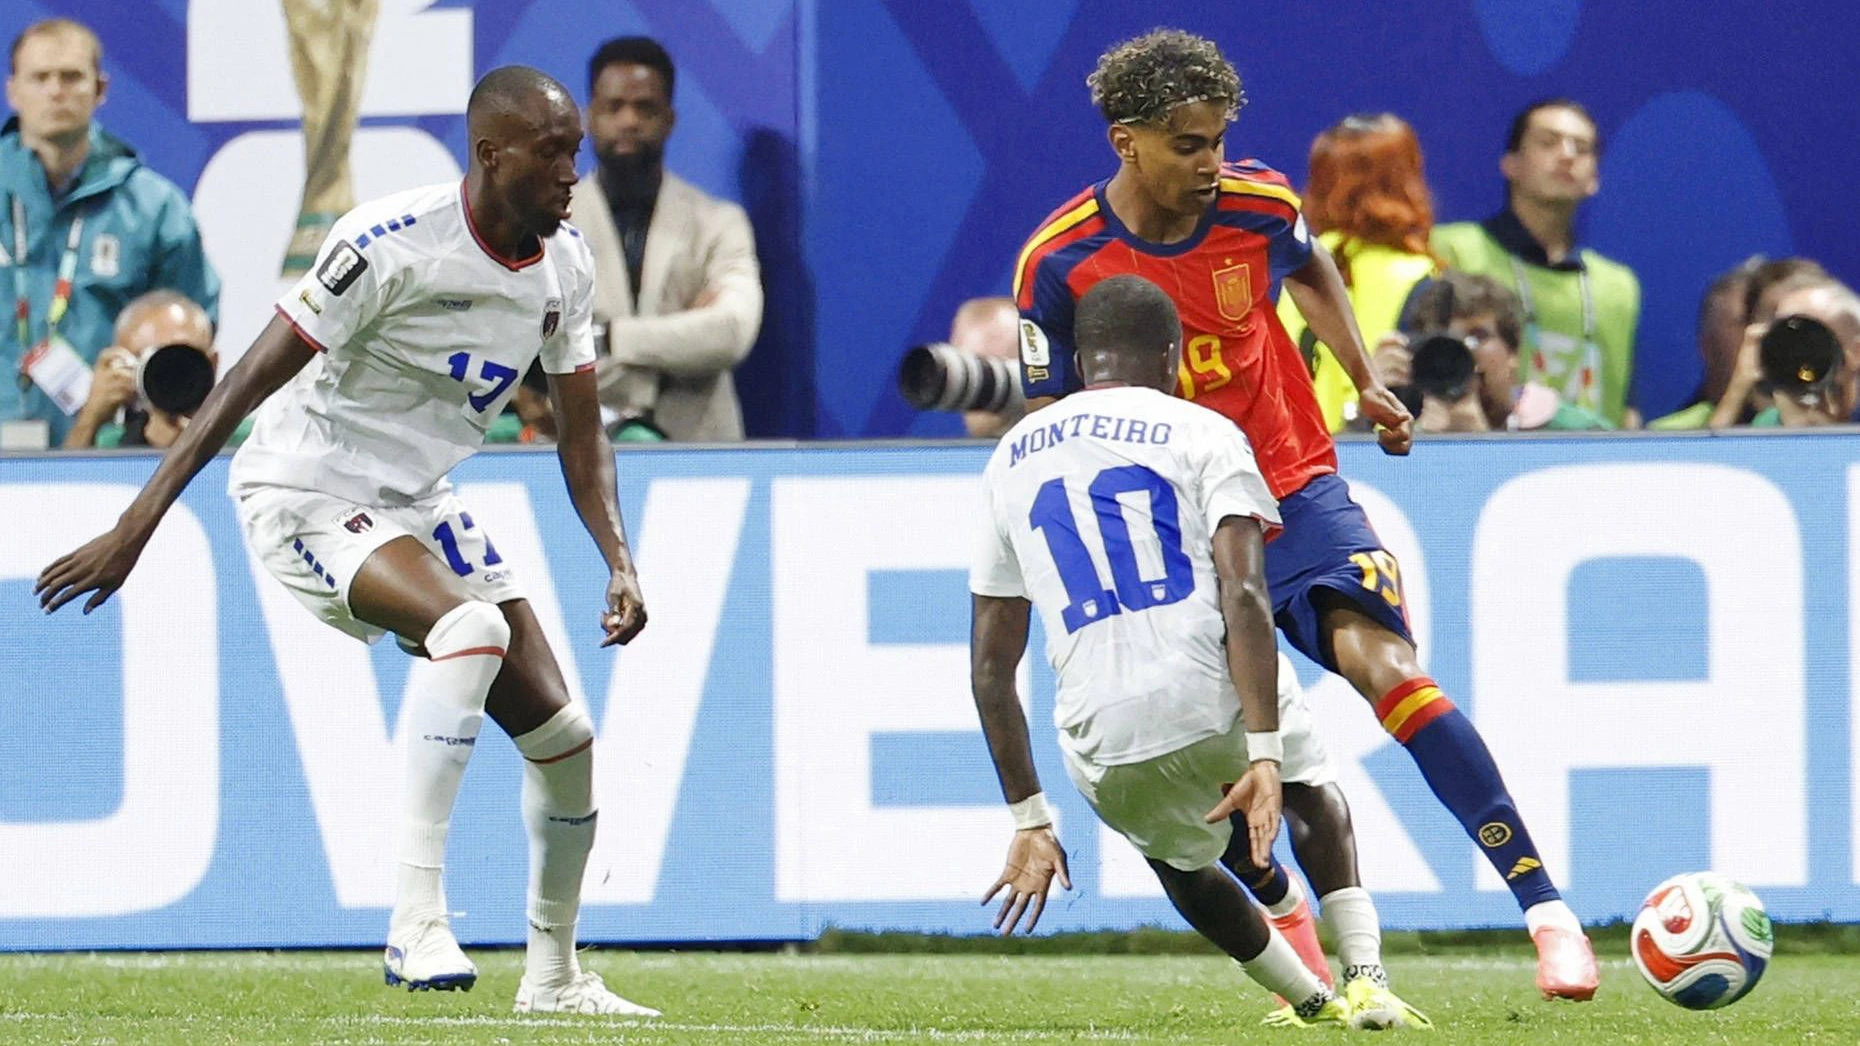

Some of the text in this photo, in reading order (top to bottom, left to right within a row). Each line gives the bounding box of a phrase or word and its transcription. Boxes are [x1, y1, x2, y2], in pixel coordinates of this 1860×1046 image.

[448, 352, 518, 413] 17
[1178, 334, 1232, 400] 19
[1009, 414, 1172, 468] MONTEIRO
[1028, 464, 1195, 635] 10
[1348, 550, 1400, 606] 19
